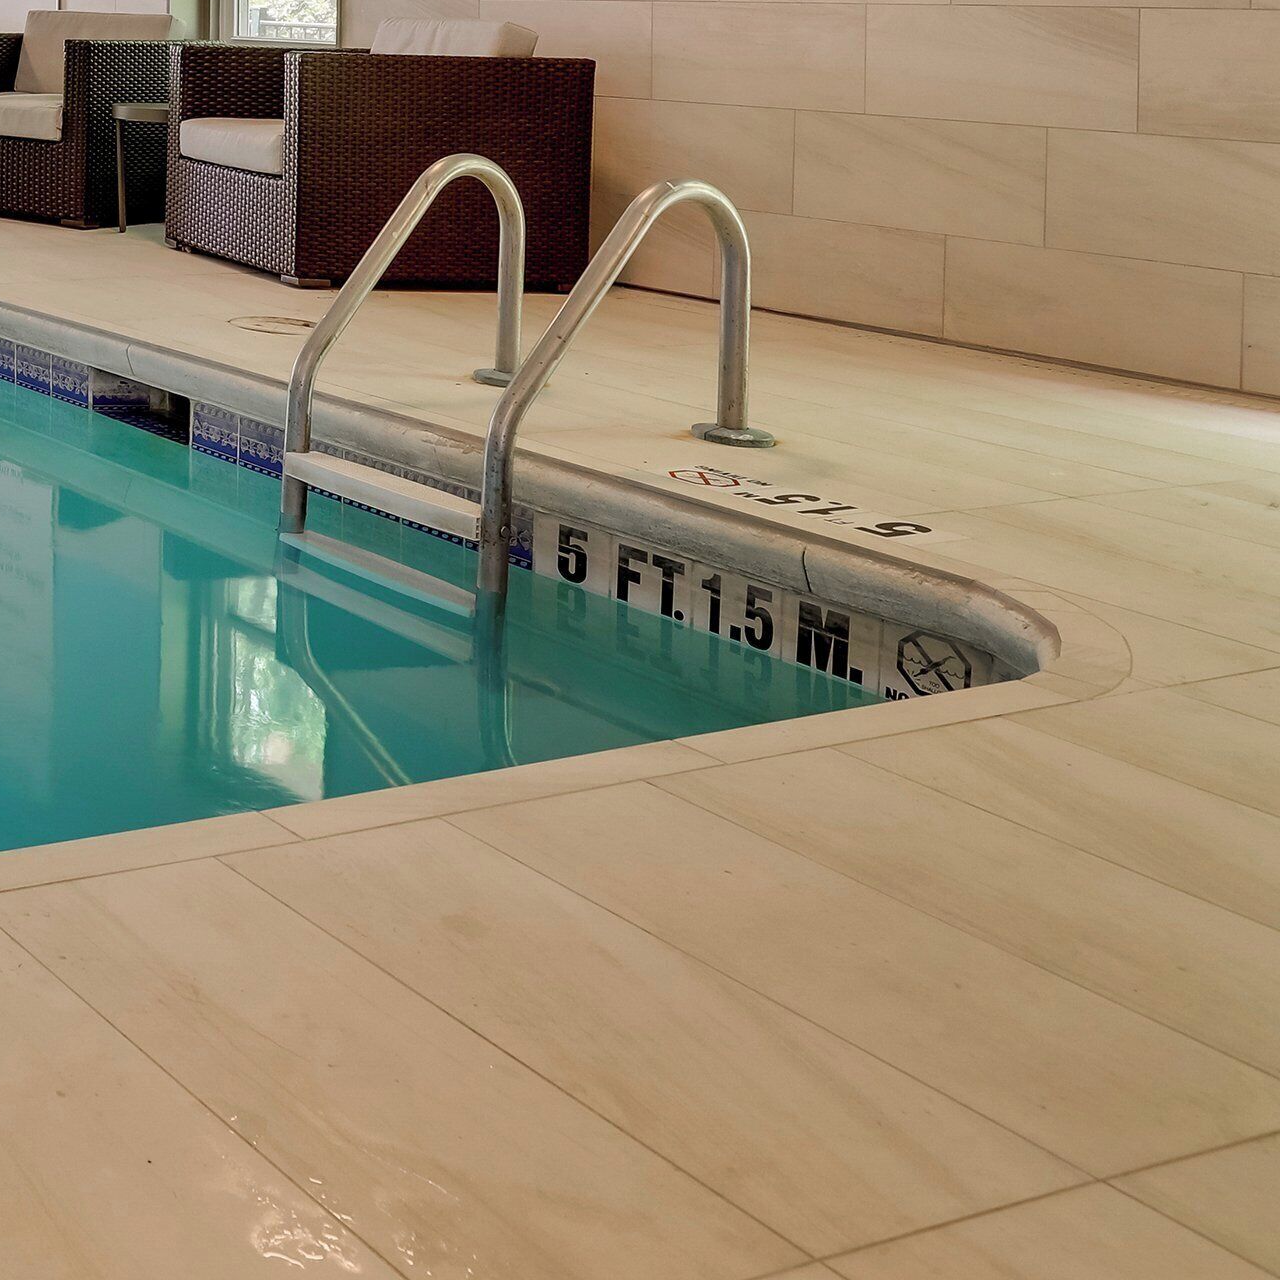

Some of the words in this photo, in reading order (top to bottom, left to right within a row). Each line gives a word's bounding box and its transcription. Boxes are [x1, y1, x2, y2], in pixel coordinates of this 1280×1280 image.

[854, 521, 932, 538] 5
[557, 523, 588, 584] 5
[616, 543, 685, 622] FT.
[701, 573, 774, 651] 1.5
[796, 600, 864, 686] M.
